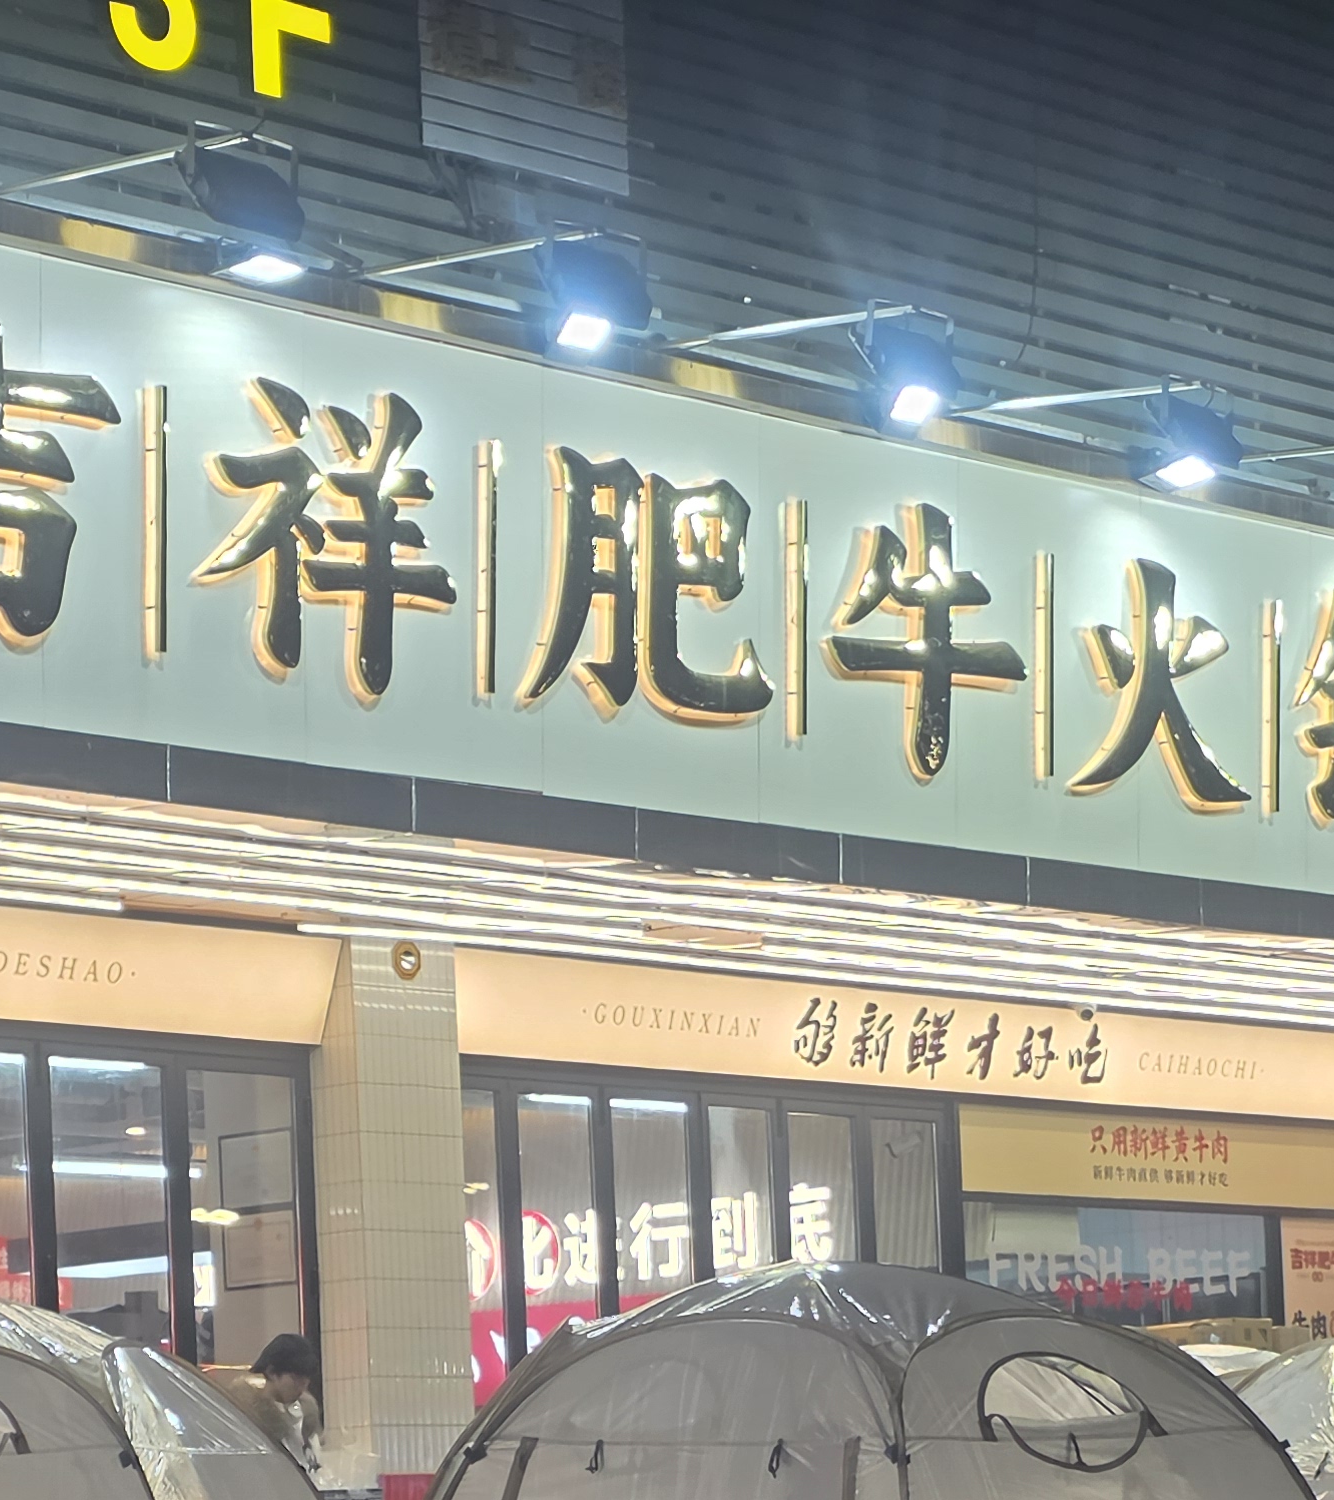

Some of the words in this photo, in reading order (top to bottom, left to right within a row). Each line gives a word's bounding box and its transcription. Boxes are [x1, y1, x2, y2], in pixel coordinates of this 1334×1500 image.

[594, 1002, 763, 1039] GOUXINXIAN
[792, 997, 1108, 1086] 够新鲜才好吃
[1138, 1051, 1259, 1081] CAIHAOCHI
[1089, 1124, 1230, 1165] 只用新鲜黄牛肉
[987, 1243, 1124, 1294] FRESH
[1147, 1247, 1252, 1299] BEEF
